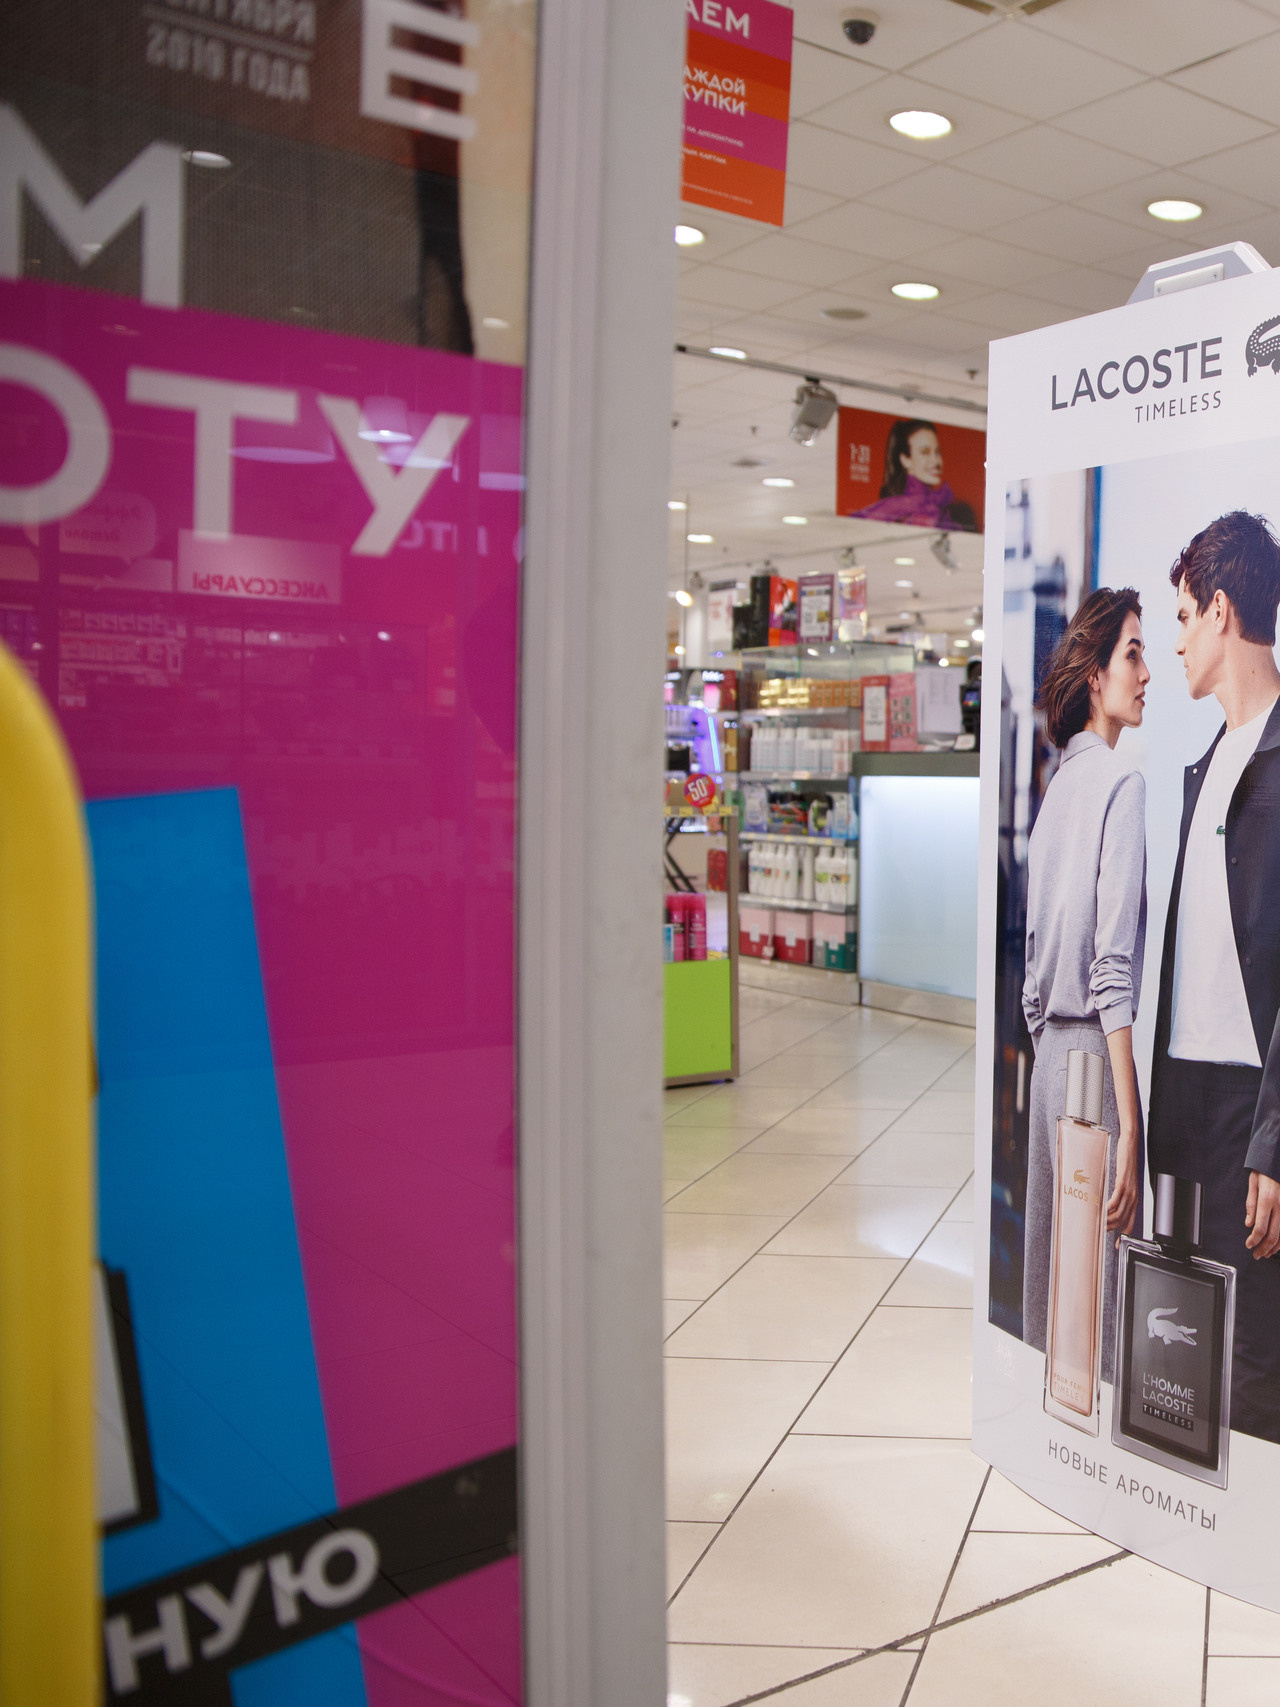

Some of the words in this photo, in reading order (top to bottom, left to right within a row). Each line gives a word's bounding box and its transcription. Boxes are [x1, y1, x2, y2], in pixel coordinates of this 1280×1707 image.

[232, 48, 311, 101] ГОДА
[1051, 336, 1222, 410] LACOSTE
[1135, 390, 1222, 424] TIMELESS
[1142, 1372, 1195, 1402] L'HOMME
[1142, 1387, 1194, 1416] LACOSTE
[1143, 1404, 1193, 1429] TIMELESS
[1048, 1438, 1108, 1485] НОВЫЕ
[1116, 1474, 1216, 1532] АРОМАТЫ
[103, 1527, 380, 1697] НУЮ
